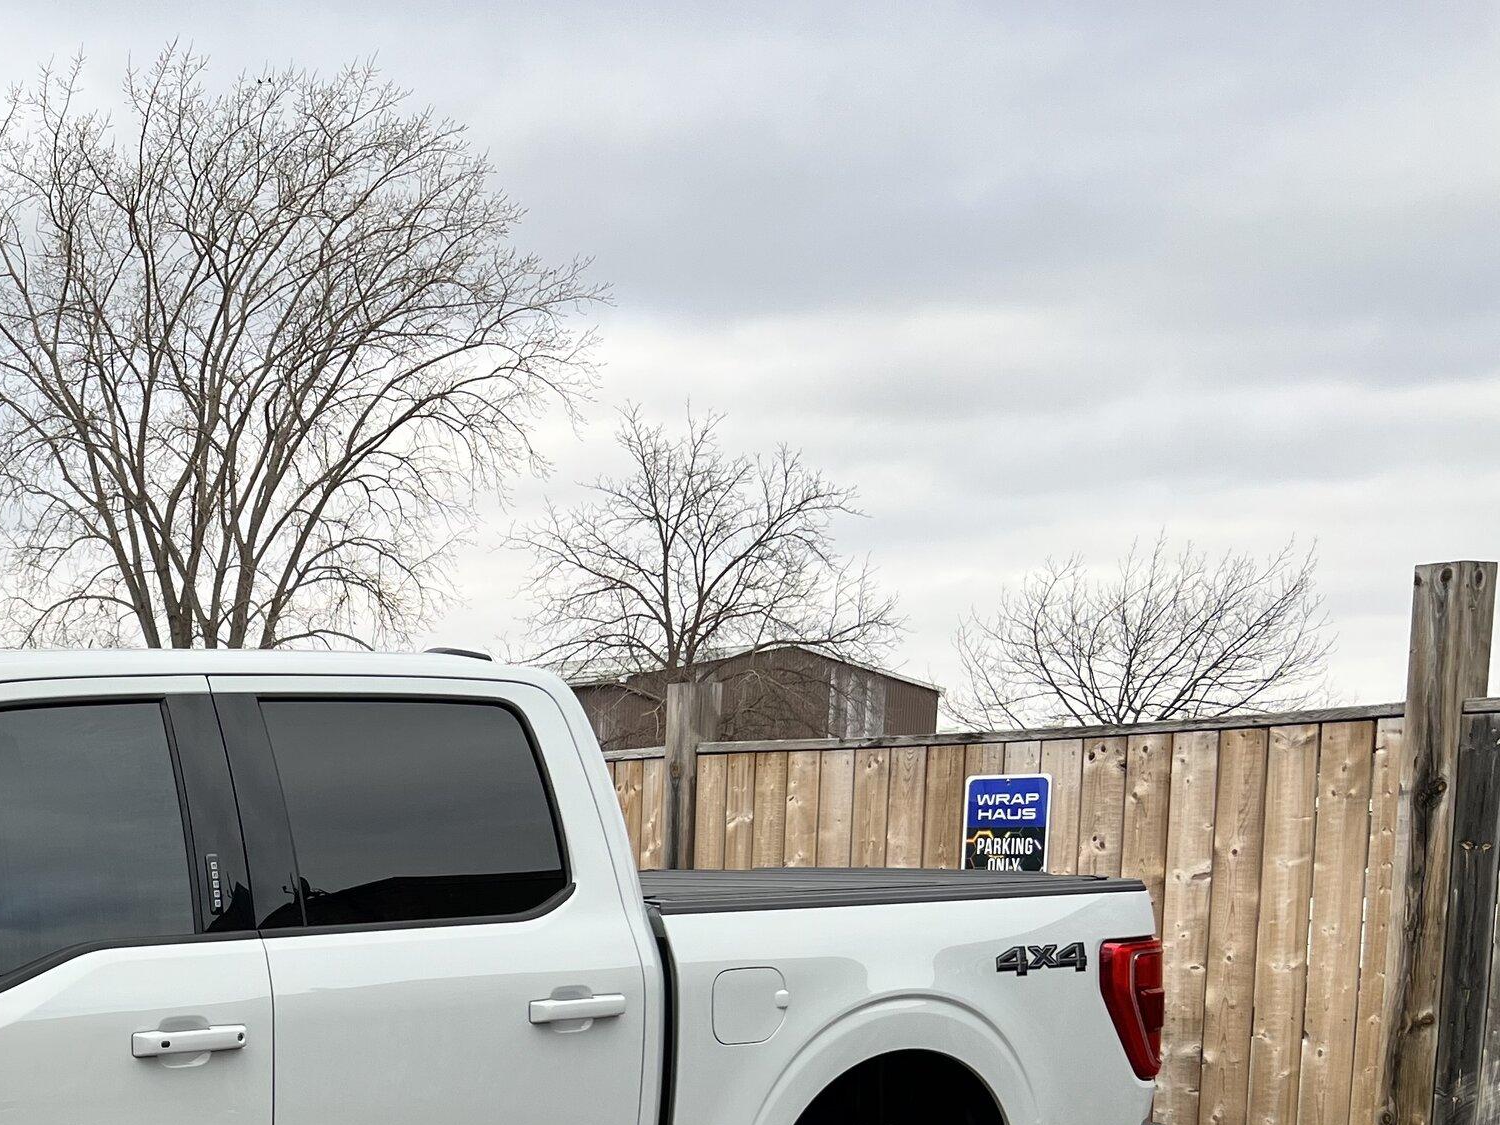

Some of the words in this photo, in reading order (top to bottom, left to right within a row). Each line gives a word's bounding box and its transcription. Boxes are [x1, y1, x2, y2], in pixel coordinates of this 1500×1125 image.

[977, 792, 1040, 805] WRAP
[977, 807, 1037, 820] HAUS
[976, 837, 1033, 855] PARKING
[987, 857, 1020, 871] ONLY
